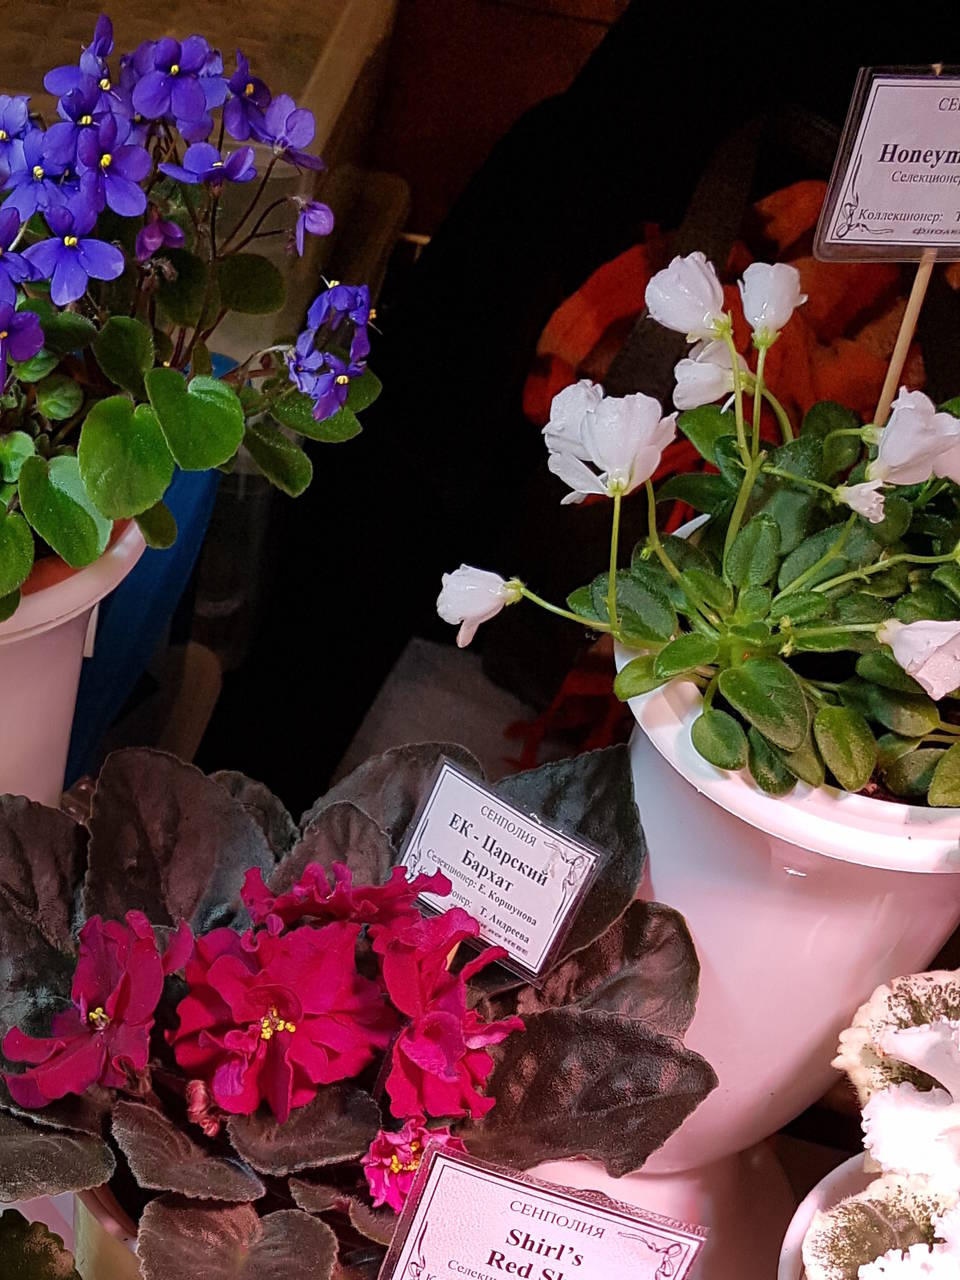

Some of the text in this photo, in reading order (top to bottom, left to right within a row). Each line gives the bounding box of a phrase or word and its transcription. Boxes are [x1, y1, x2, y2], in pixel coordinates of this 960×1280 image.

[858, 208, 944, 223] Коллекционер:
[479, 804, 538, 847] СЕНПОЛИЯ
[448, 811, 474, 840] ЕК
[481, 834, 549, 887] Царский
[425, 848, 538, 926] Селекционер: Е. Коршунова
[461, 849, 515, 892] Бархат
[478, 905, 489, 918] Т.
[489, 914, 530, 944] Андреева
[508, 1200, 607, 1240] СЕНПОЛИЯ
[485, 1249, 535, 1280] Red
[505, 1227, 584, 1267] Shirl's
